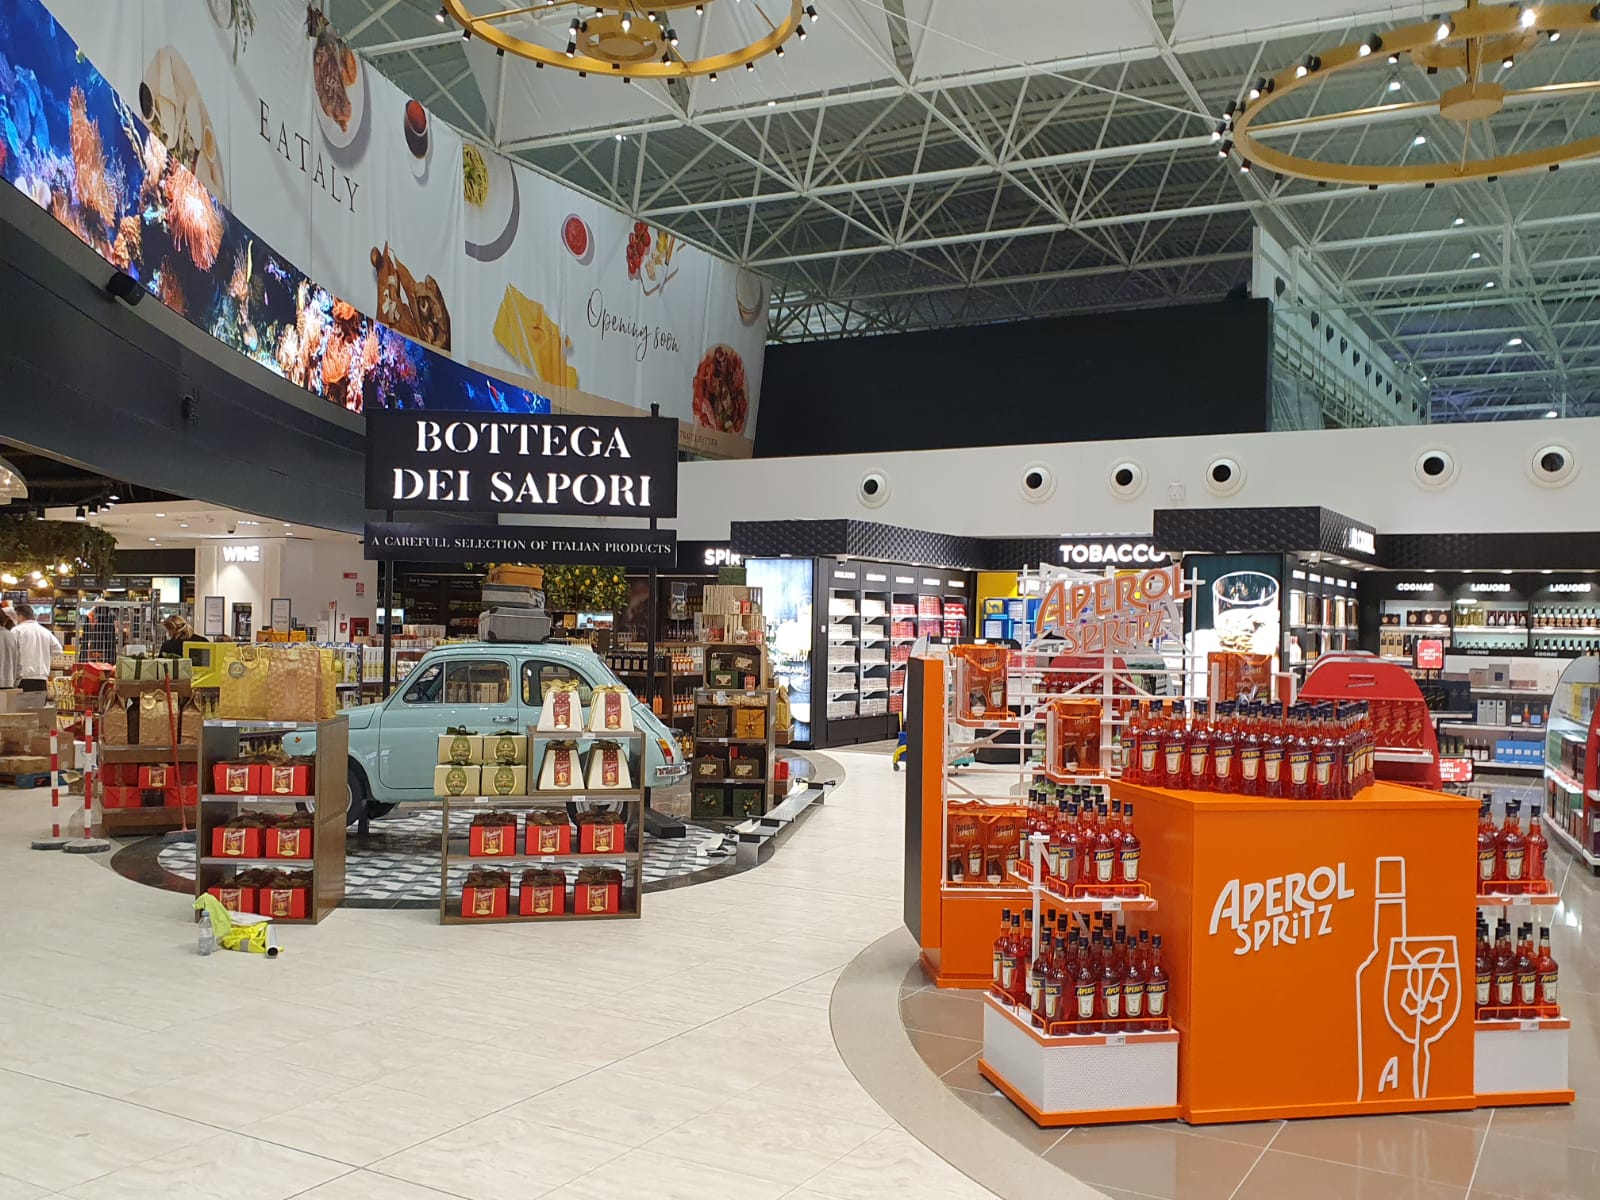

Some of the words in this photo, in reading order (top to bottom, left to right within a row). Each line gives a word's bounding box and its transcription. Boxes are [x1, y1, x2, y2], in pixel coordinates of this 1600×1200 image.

[258, 97, 361, 214] EATALY
[587, 288, 650, 362] Opening
[653, 325, 681, 353] soon
[416, 420, 632, 459] BOTTEGA
[392, 467, 471, 502] DEI
[490, 471, 652, 507] SAPORI
[222, 546, 260, 562] WINE
[371, 536, 381, 546] A
[384, 536, 451, 548] CAREFULL
[454, 538, 526, 551] SELECTION
[530, 540, 549, 551] OF
[552, 540, 601, 552] ITALIAN
[605, 542, 671, 555] PRODUCTS
[1035, 564, 1192, 634] APEROL
[1396, 582, 1435, 592] COGNAC
[1470, 583, 1511, 593] LIQUORS
[1549, 583, 1592, 593] LIQUORS
[1209, 862, 1355, 936] APEROL
[1378, 1056, 1398, 1093] A
